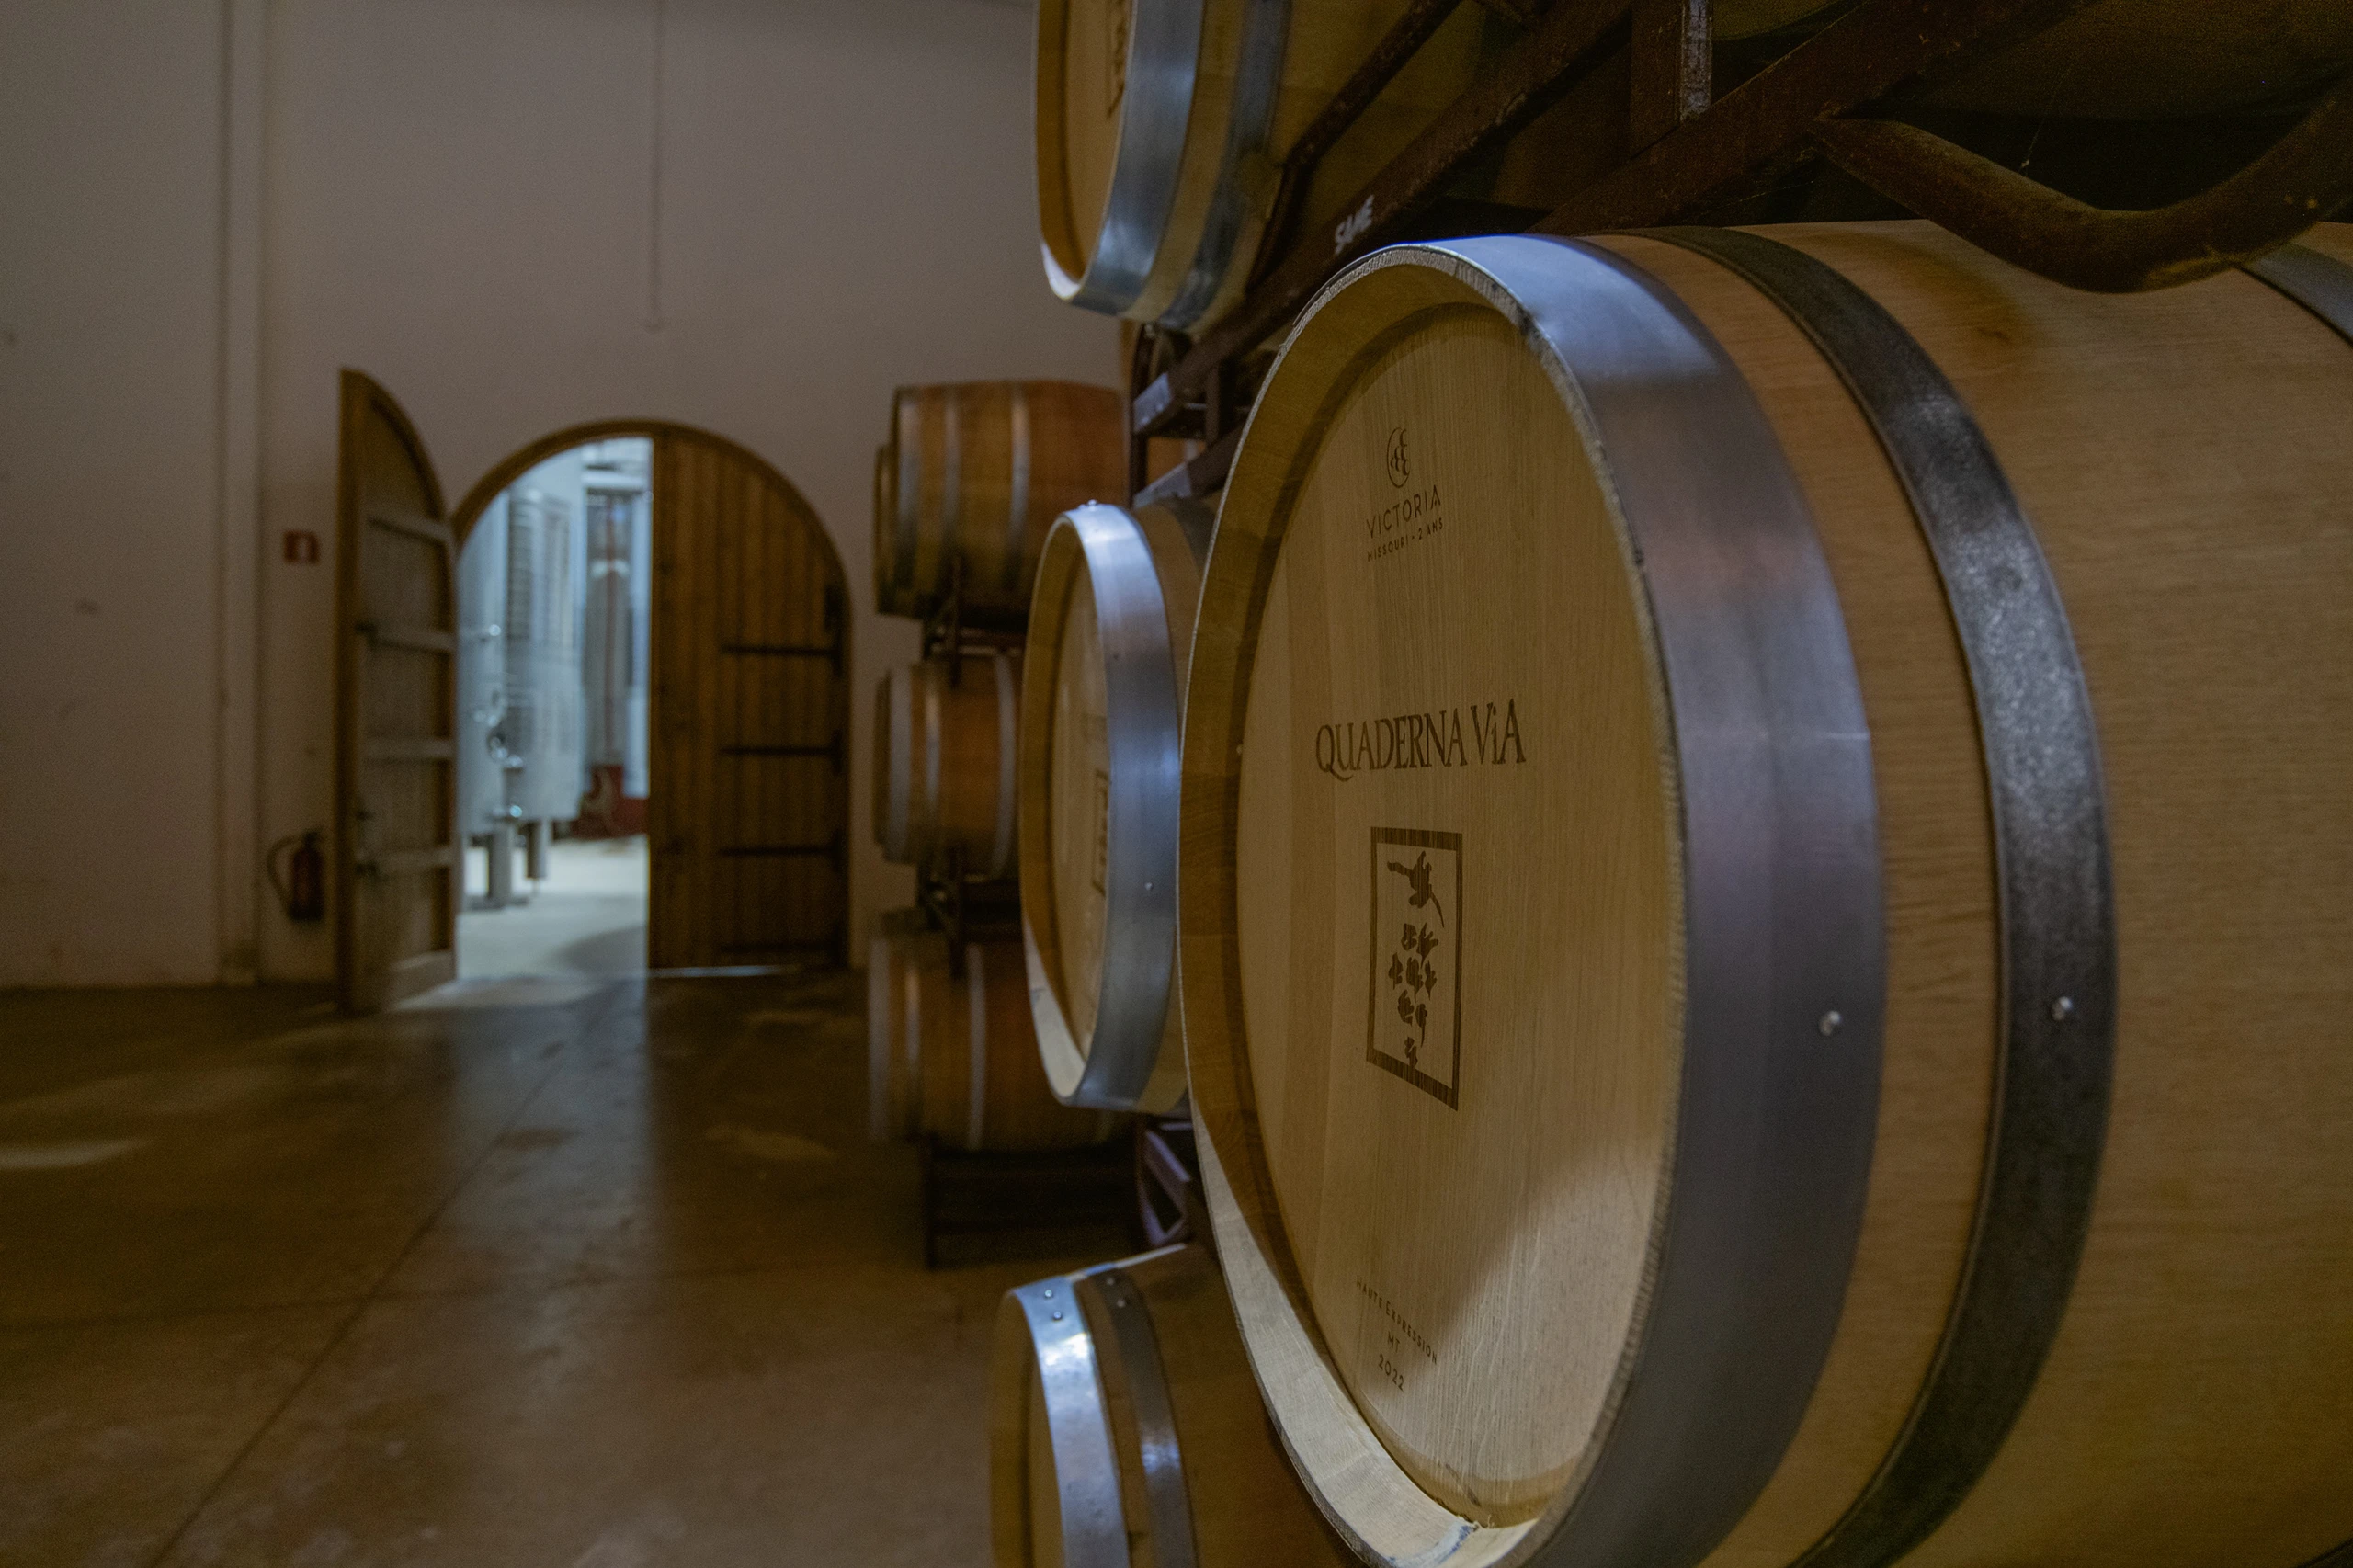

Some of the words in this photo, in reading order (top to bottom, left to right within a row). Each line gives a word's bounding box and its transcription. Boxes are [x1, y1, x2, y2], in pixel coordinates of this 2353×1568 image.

[1366, 484, 1441, 540] VICTORIA
[1367, 534, 1409, 562] MISSOURI
[1418, 527, 1423, 540] 2
[1426, 517, 1443, 537] ANS
[1315, 707, 1468, 782] QUADERNA
[1356, 1275, 1383, 1310] HAUTE
[1385, 1300, 1438, 1365] EXPRESSION
[1387, 1331, 1401, 1353] MT
[1379, 1353, 1404, 1392] 2022
